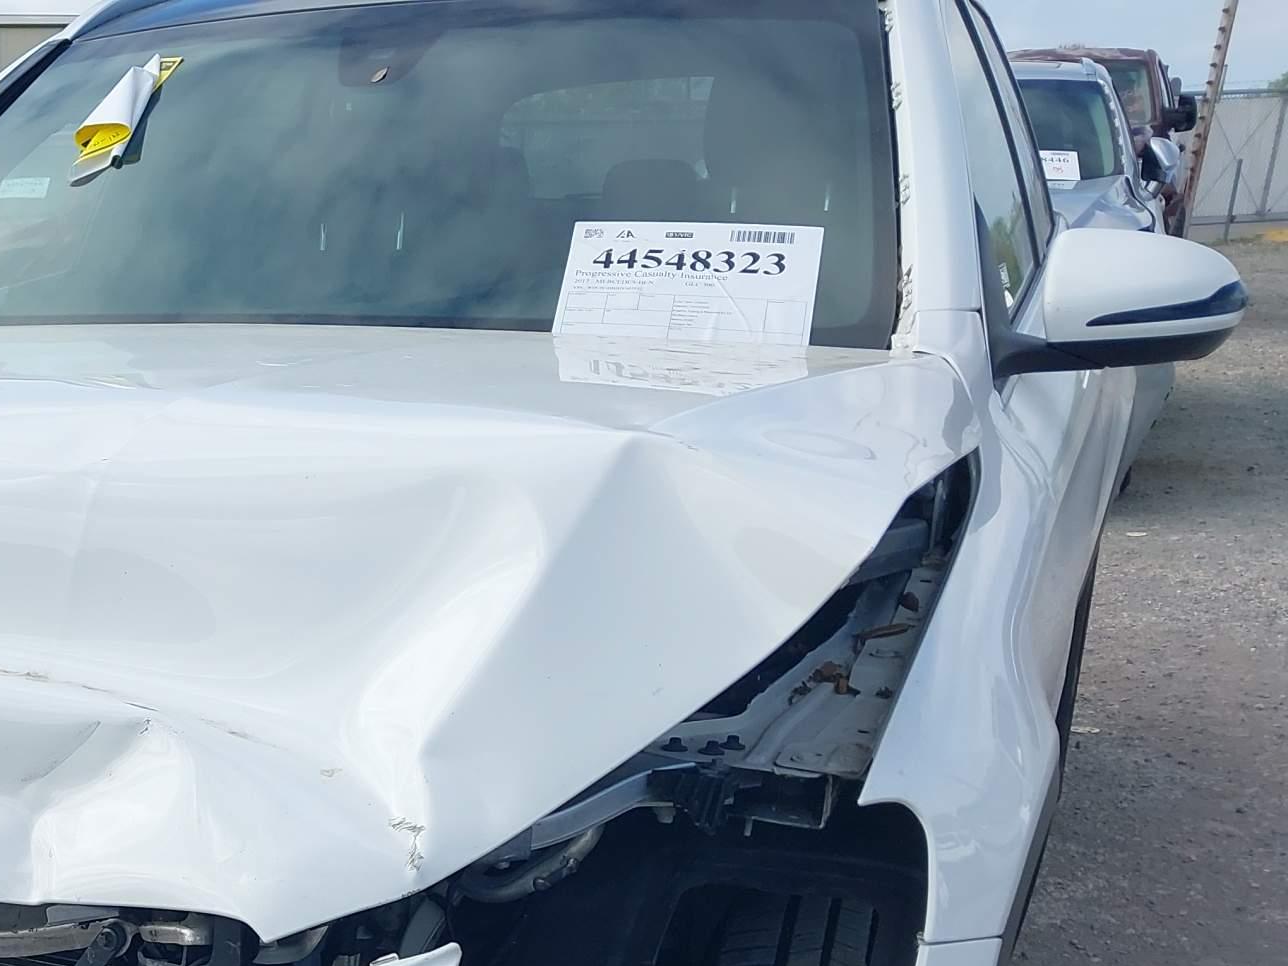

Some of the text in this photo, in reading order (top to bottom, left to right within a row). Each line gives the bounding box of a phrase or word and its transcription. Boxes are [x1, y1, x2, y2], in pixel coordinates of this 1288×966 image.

[592, 248, 786, 276] 44548323
[575, 269, 728, 281] Progressive Casualty Insurance
